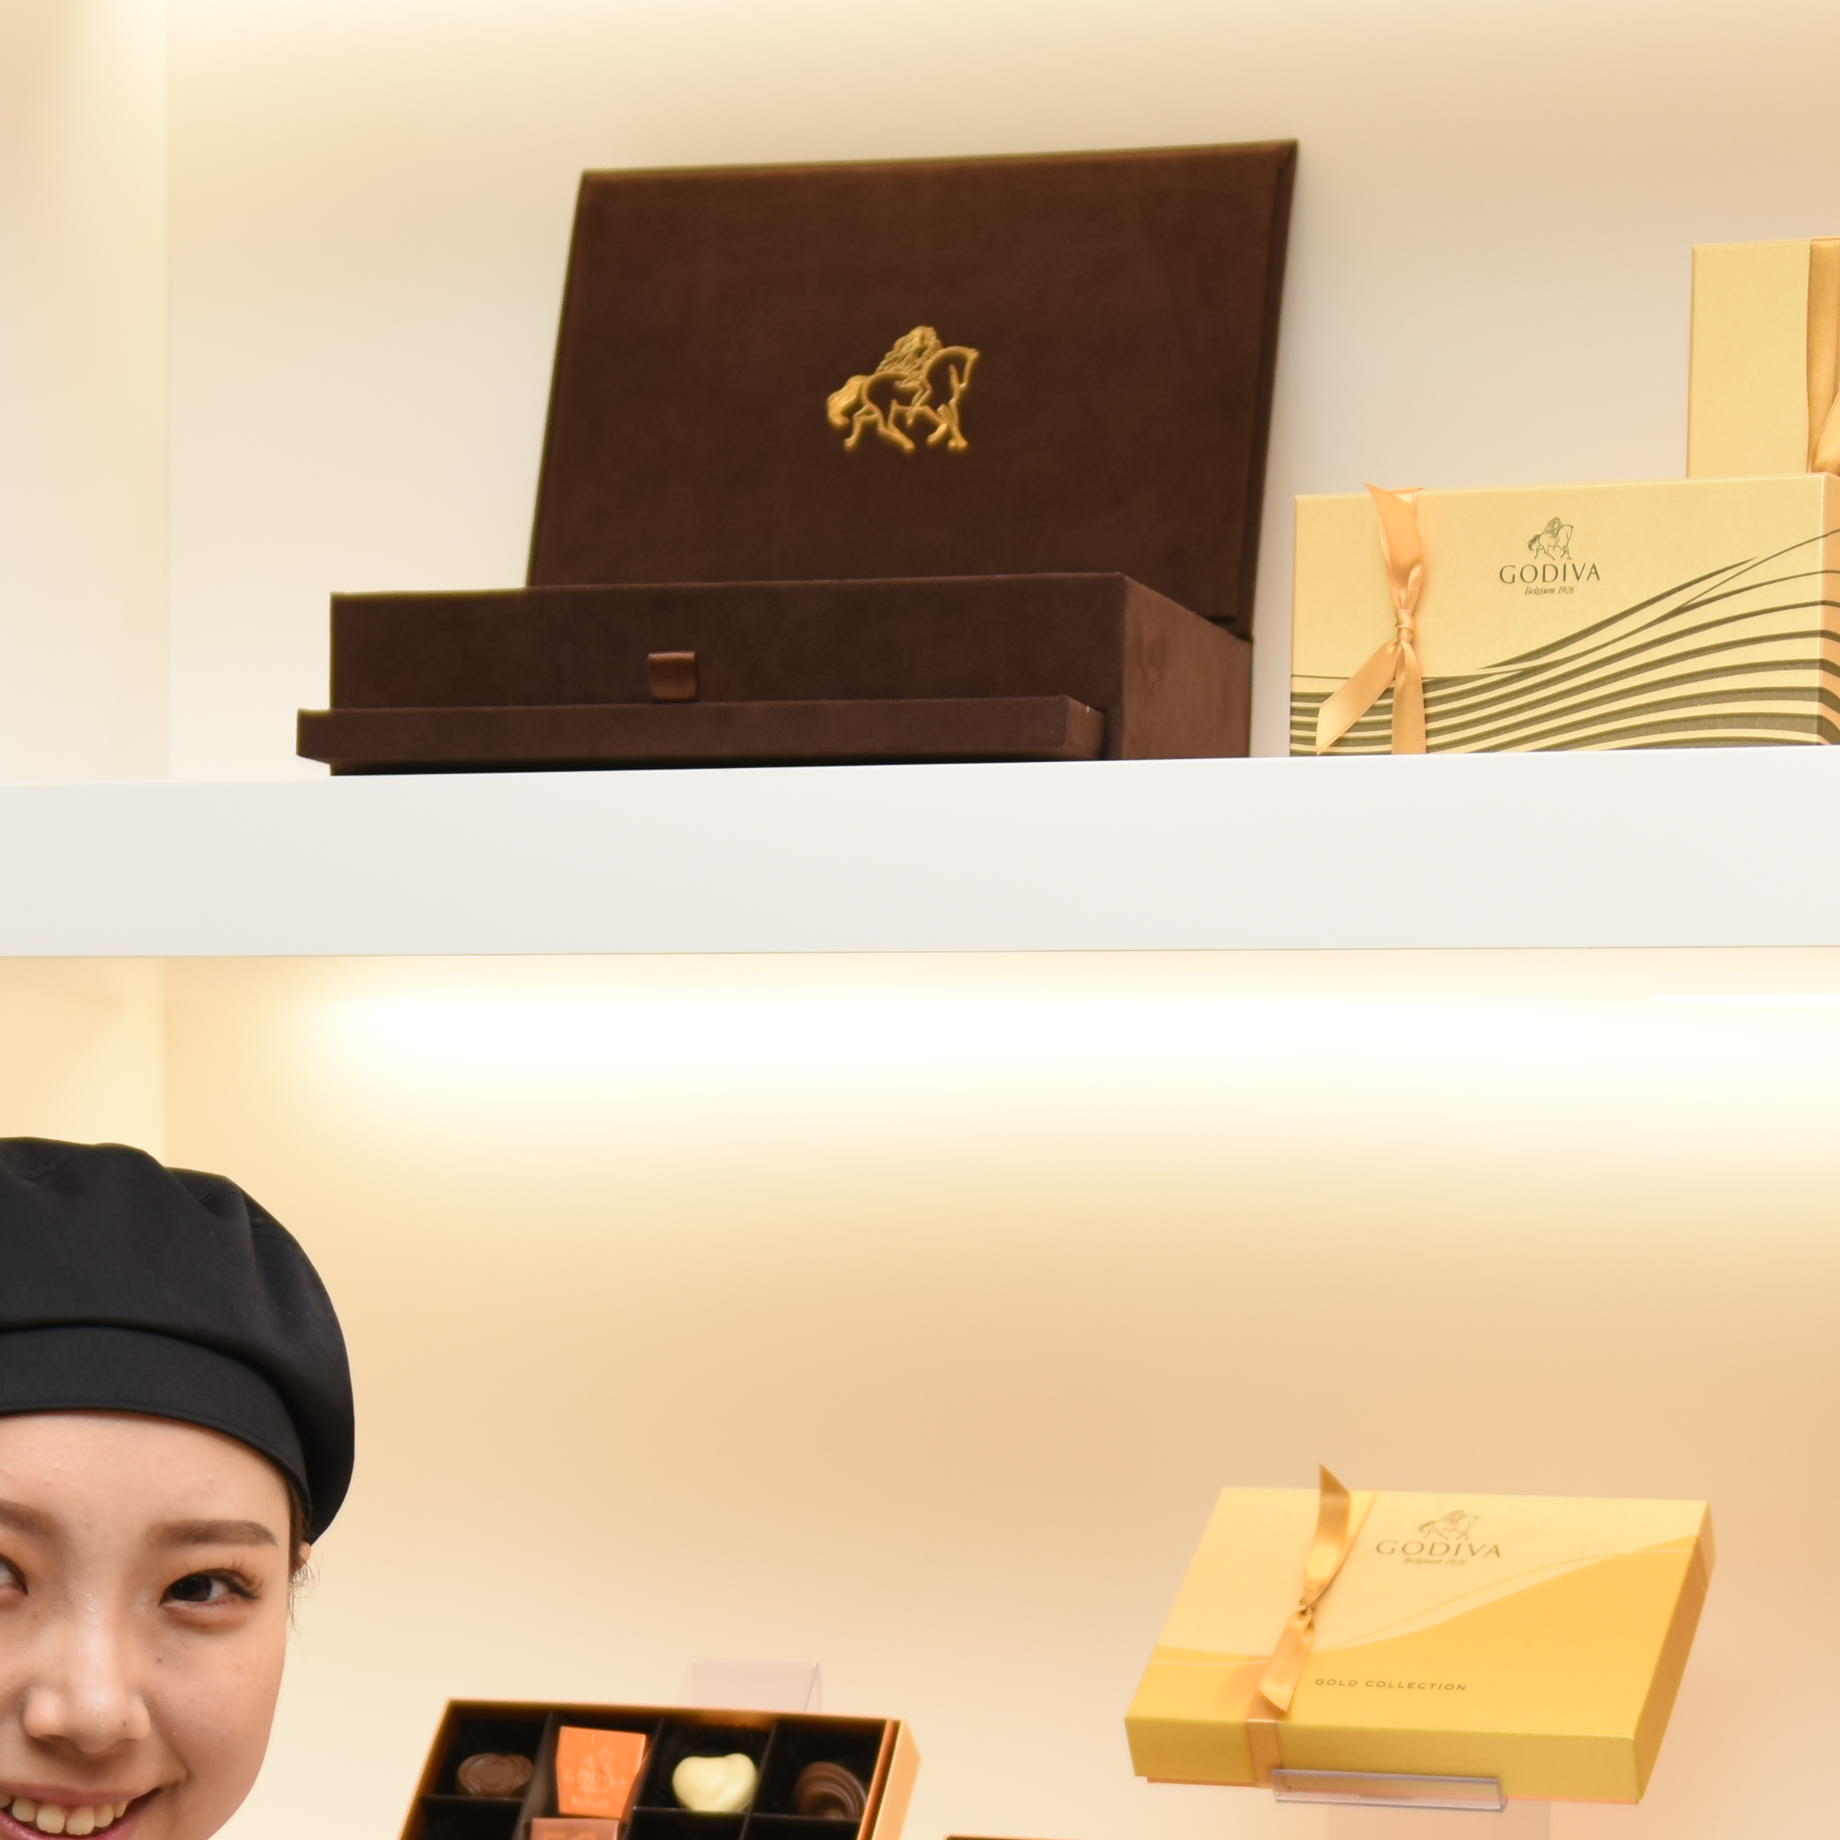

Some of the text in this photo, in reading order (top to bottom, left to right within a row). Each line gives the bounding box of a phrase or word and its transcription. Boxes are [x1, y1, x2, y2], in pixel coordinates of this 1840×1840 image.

[1499, 562, 1601, 585] GODIVA
[1375, 1539, 1501, 1559] GODIVA
[1314, 1677, 1468, 1692] GOLD COLLECTION
